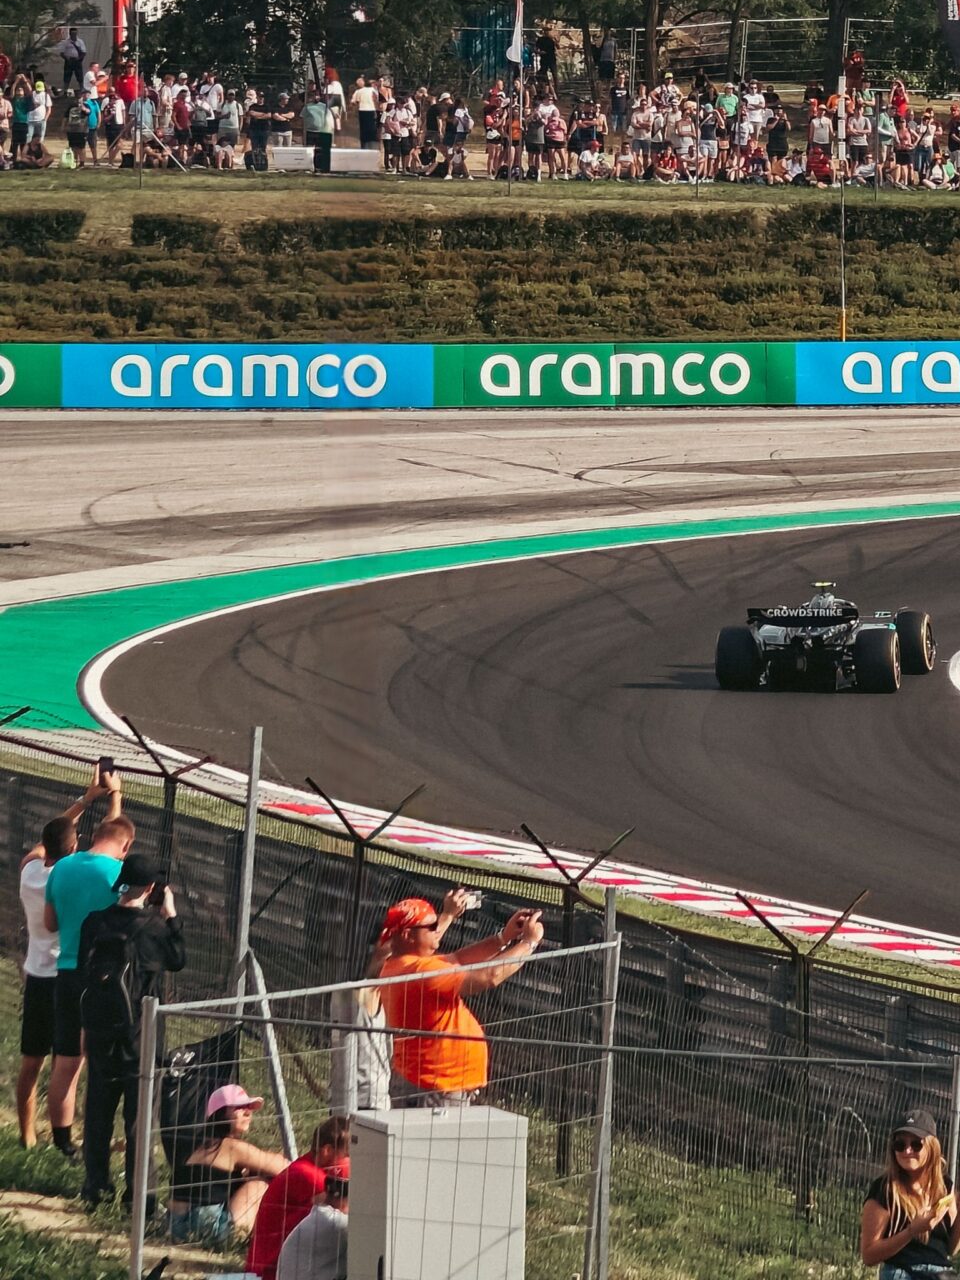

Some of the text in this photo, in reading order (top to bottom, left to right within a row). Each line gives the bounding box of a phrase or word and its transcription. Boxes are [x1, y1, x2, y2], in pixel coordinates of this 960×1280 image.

[110, 354, 387, 397] aramco
[480, 353, 751, 396] aramco
[767, 608, 843, 617] CROWDSTRIKE
